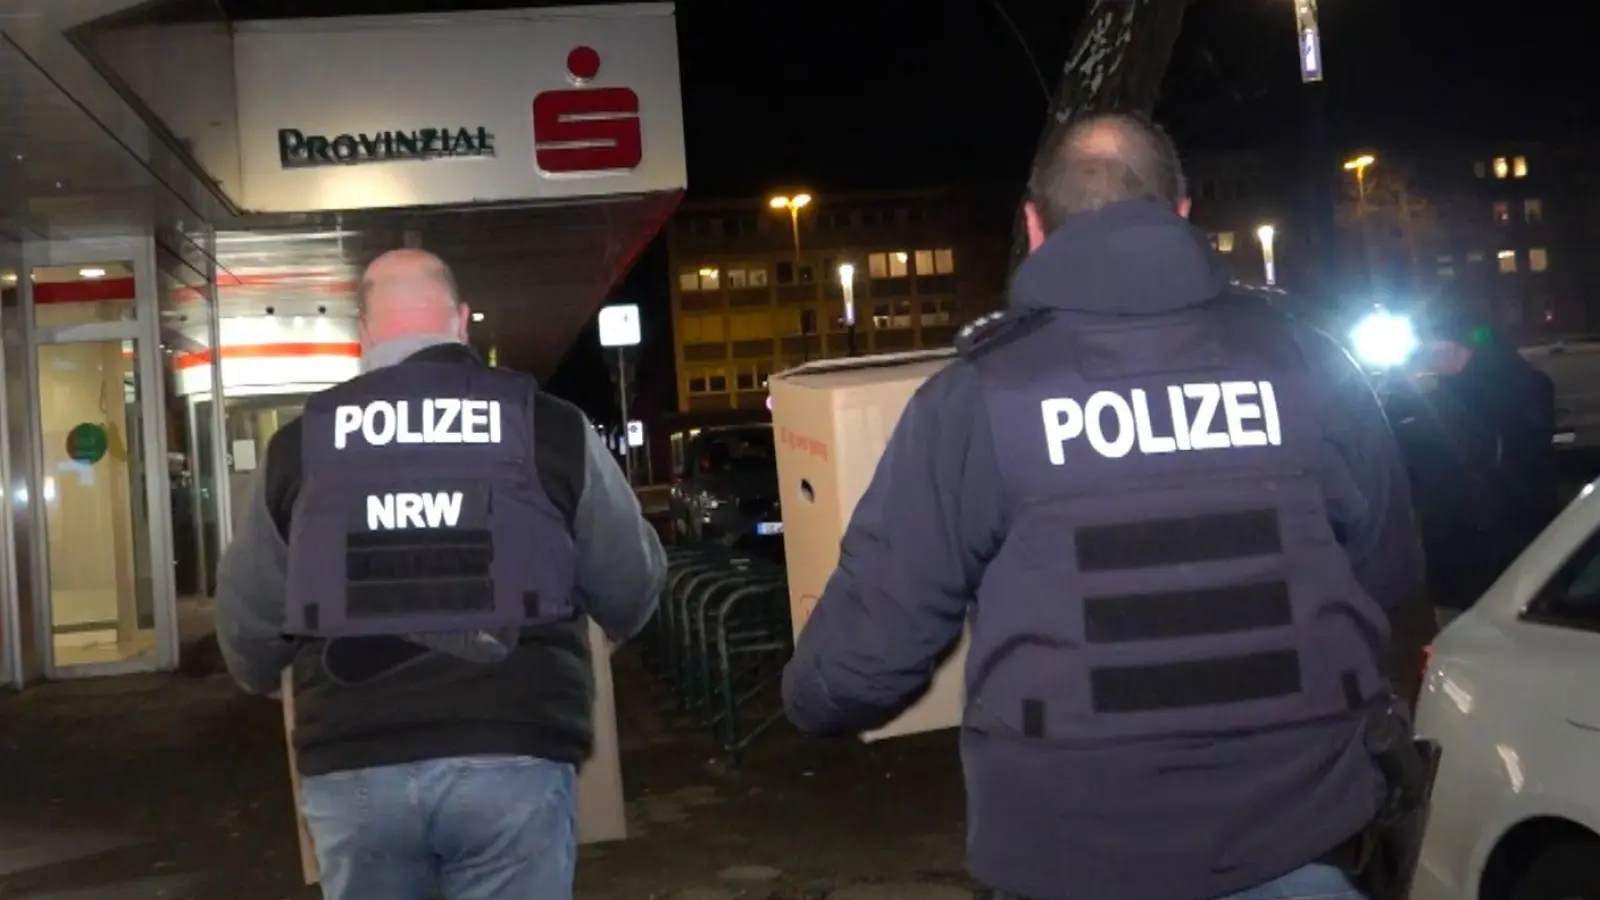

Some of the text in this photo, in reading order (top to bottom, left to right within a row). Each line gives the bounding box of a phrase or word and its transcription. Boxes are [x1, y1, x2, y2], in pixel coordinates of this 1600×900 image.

[278, 126, 496, 168] PROVINZIAL
[335, 398, 501, 449] POLIZEI
[1041, 380, 1281, 465] POLIZEI
[366, 491, 463, 530] NRW
